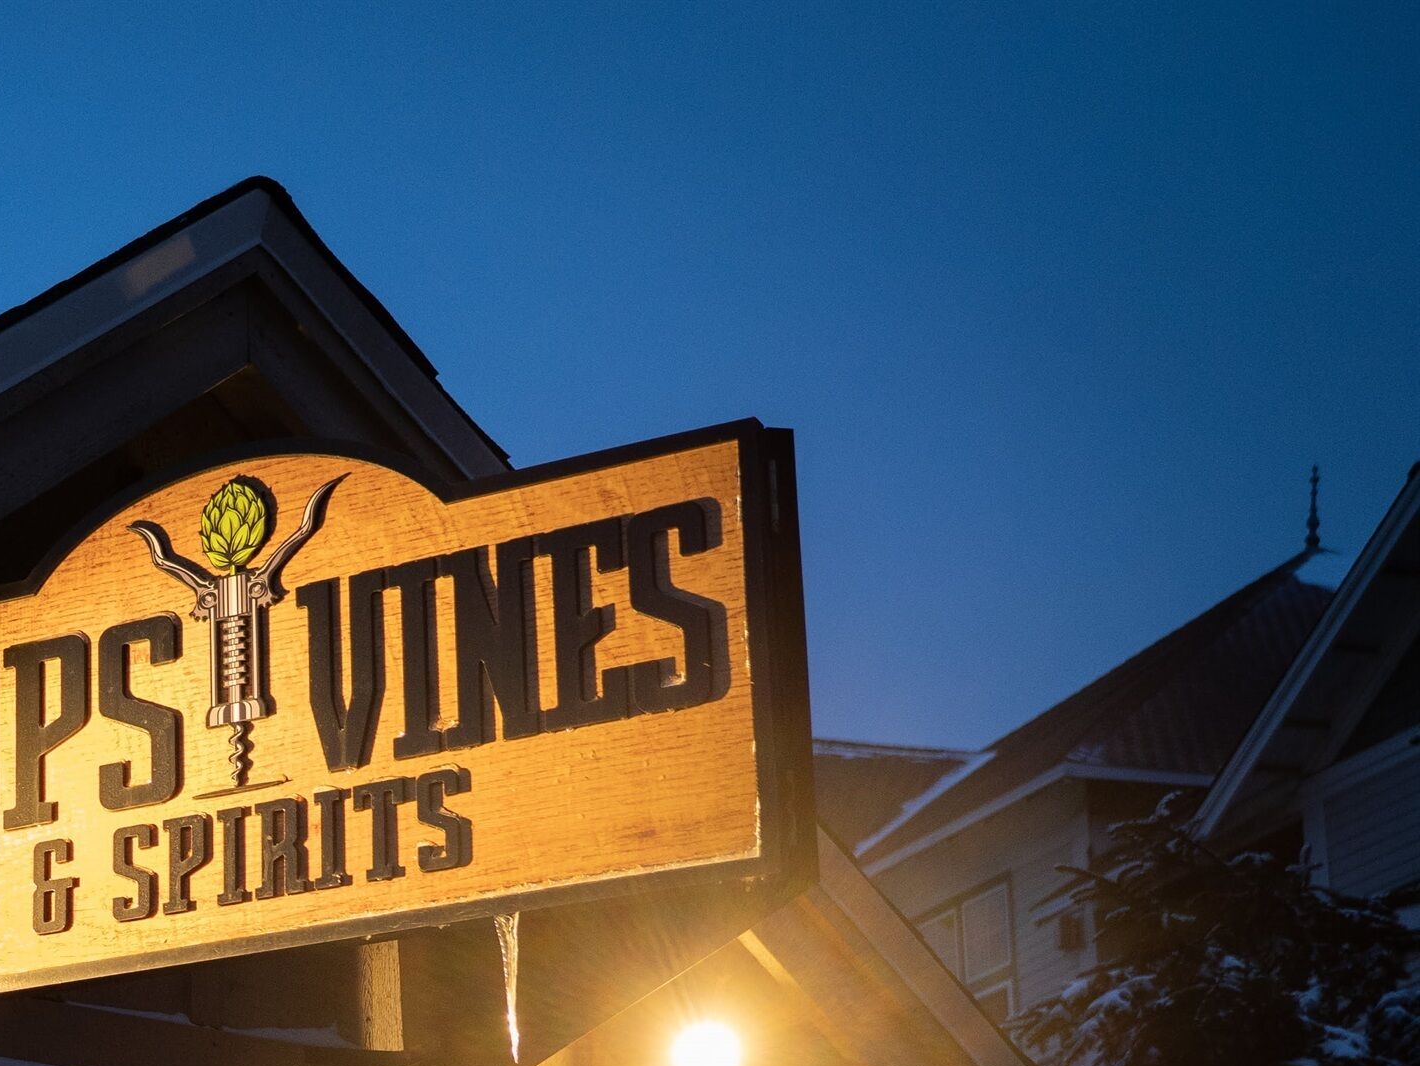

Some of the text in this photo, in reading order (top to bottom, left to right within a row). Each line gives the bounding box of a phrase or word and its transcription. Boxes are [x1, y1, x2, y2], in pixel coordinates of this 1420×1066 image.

[296, 497, 730, 772] VINES
[33, 764, 472, 935] & SPIRITS
